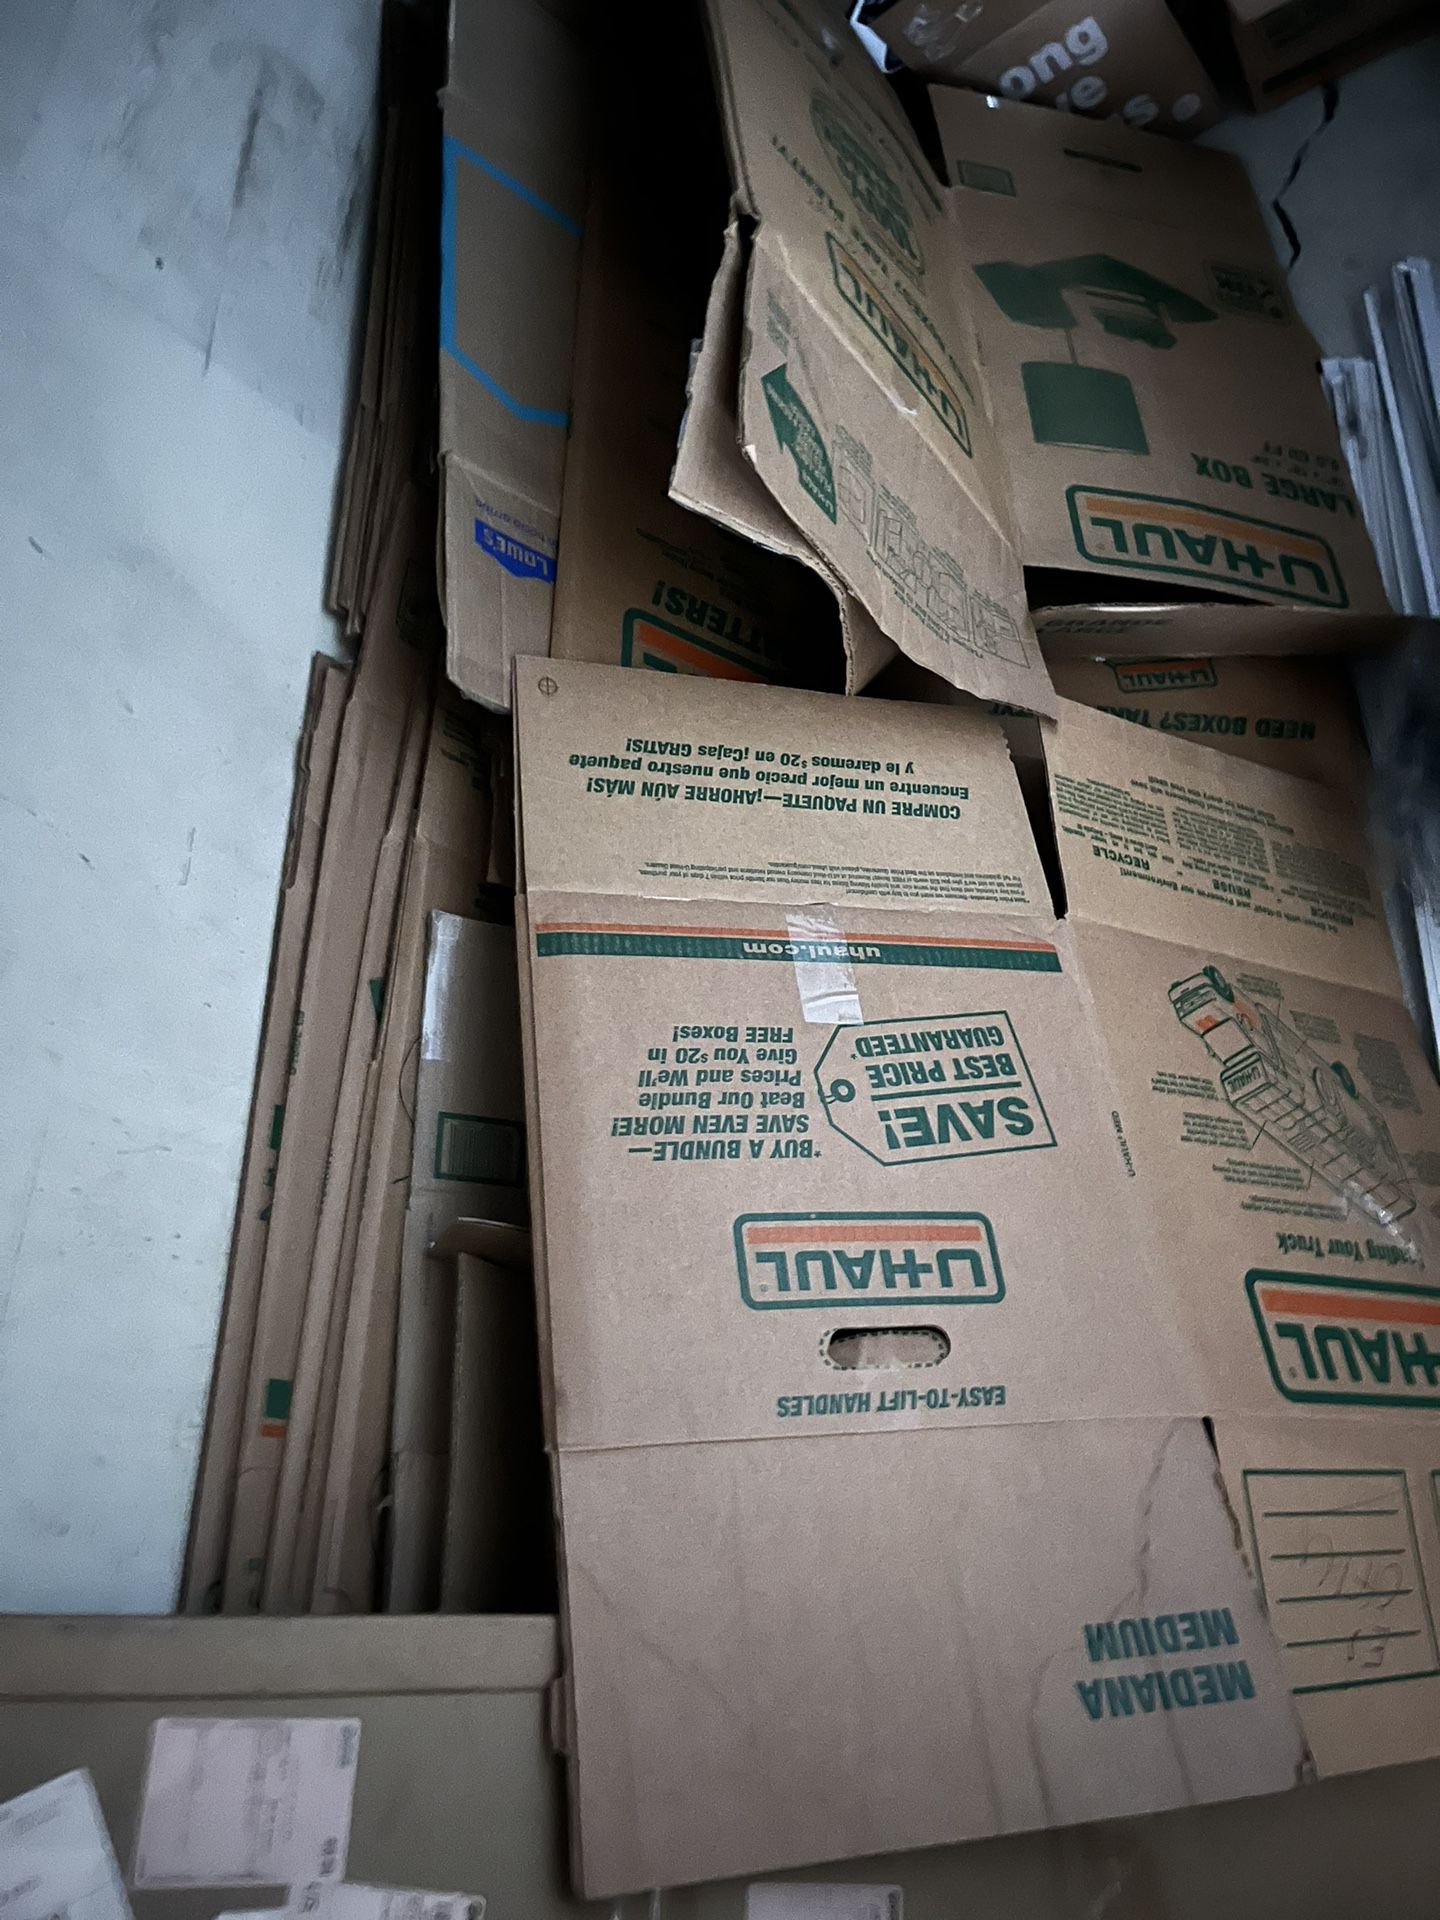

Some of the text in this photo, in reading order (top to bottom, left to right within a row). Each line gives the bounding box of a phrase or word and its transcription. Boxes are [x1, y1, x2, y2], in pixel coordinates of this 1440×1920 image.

[1190, 452, 1253, 488] BOX
[1261, 472, 1355, 516] LARGE
[1159, 712, 1247, 735] BOXES?
[1256, 719, 1315, 739] NEED
[625, 737, 914, 775] y le daremos $20 en ¡Cajas GRATIS!
[568, 754, 968, 799] Encuentre un mejor precio que nuestro paquete
[586, 777, 635, 797] MÁS!
[640, 781, 680, 801] AÚN
[862, 799, 885, 814] UN
[891, 801, 960, 819] COMPRE
[1092, 844, 1149, 870] RECYCLE
[743, 943, 881, 961] uhaul.com
[672, 1025, 793, 1043] FREE Boxes!
[647, 1047, 797, 1064] Give You $20 in
[695, 1069, 734, 1086] and
[740, 1069, 801, 1086] Prices
[864, 1052, 1017, 1088] BEST PRICE
[638, 1091, 804, 1110] Beat Our Bundle
[610, 1113, 809, 1136] SAVE EVEN MORE!
[877, 1096, 1034, 1150] SAVE!
[748, 1139, 764, 1158] A
[1276, 1232, 1425, 1270] ading Your Truck
[754, 1248, 987, 1291] U-HAUL
[776, 1385, 1005, 1417] EASY-TO-LIFT HANDLES
[1083, 1607, 1239, 1662] MEDIUM
[1074, 1660, 1256, 1721] MEDIANA
